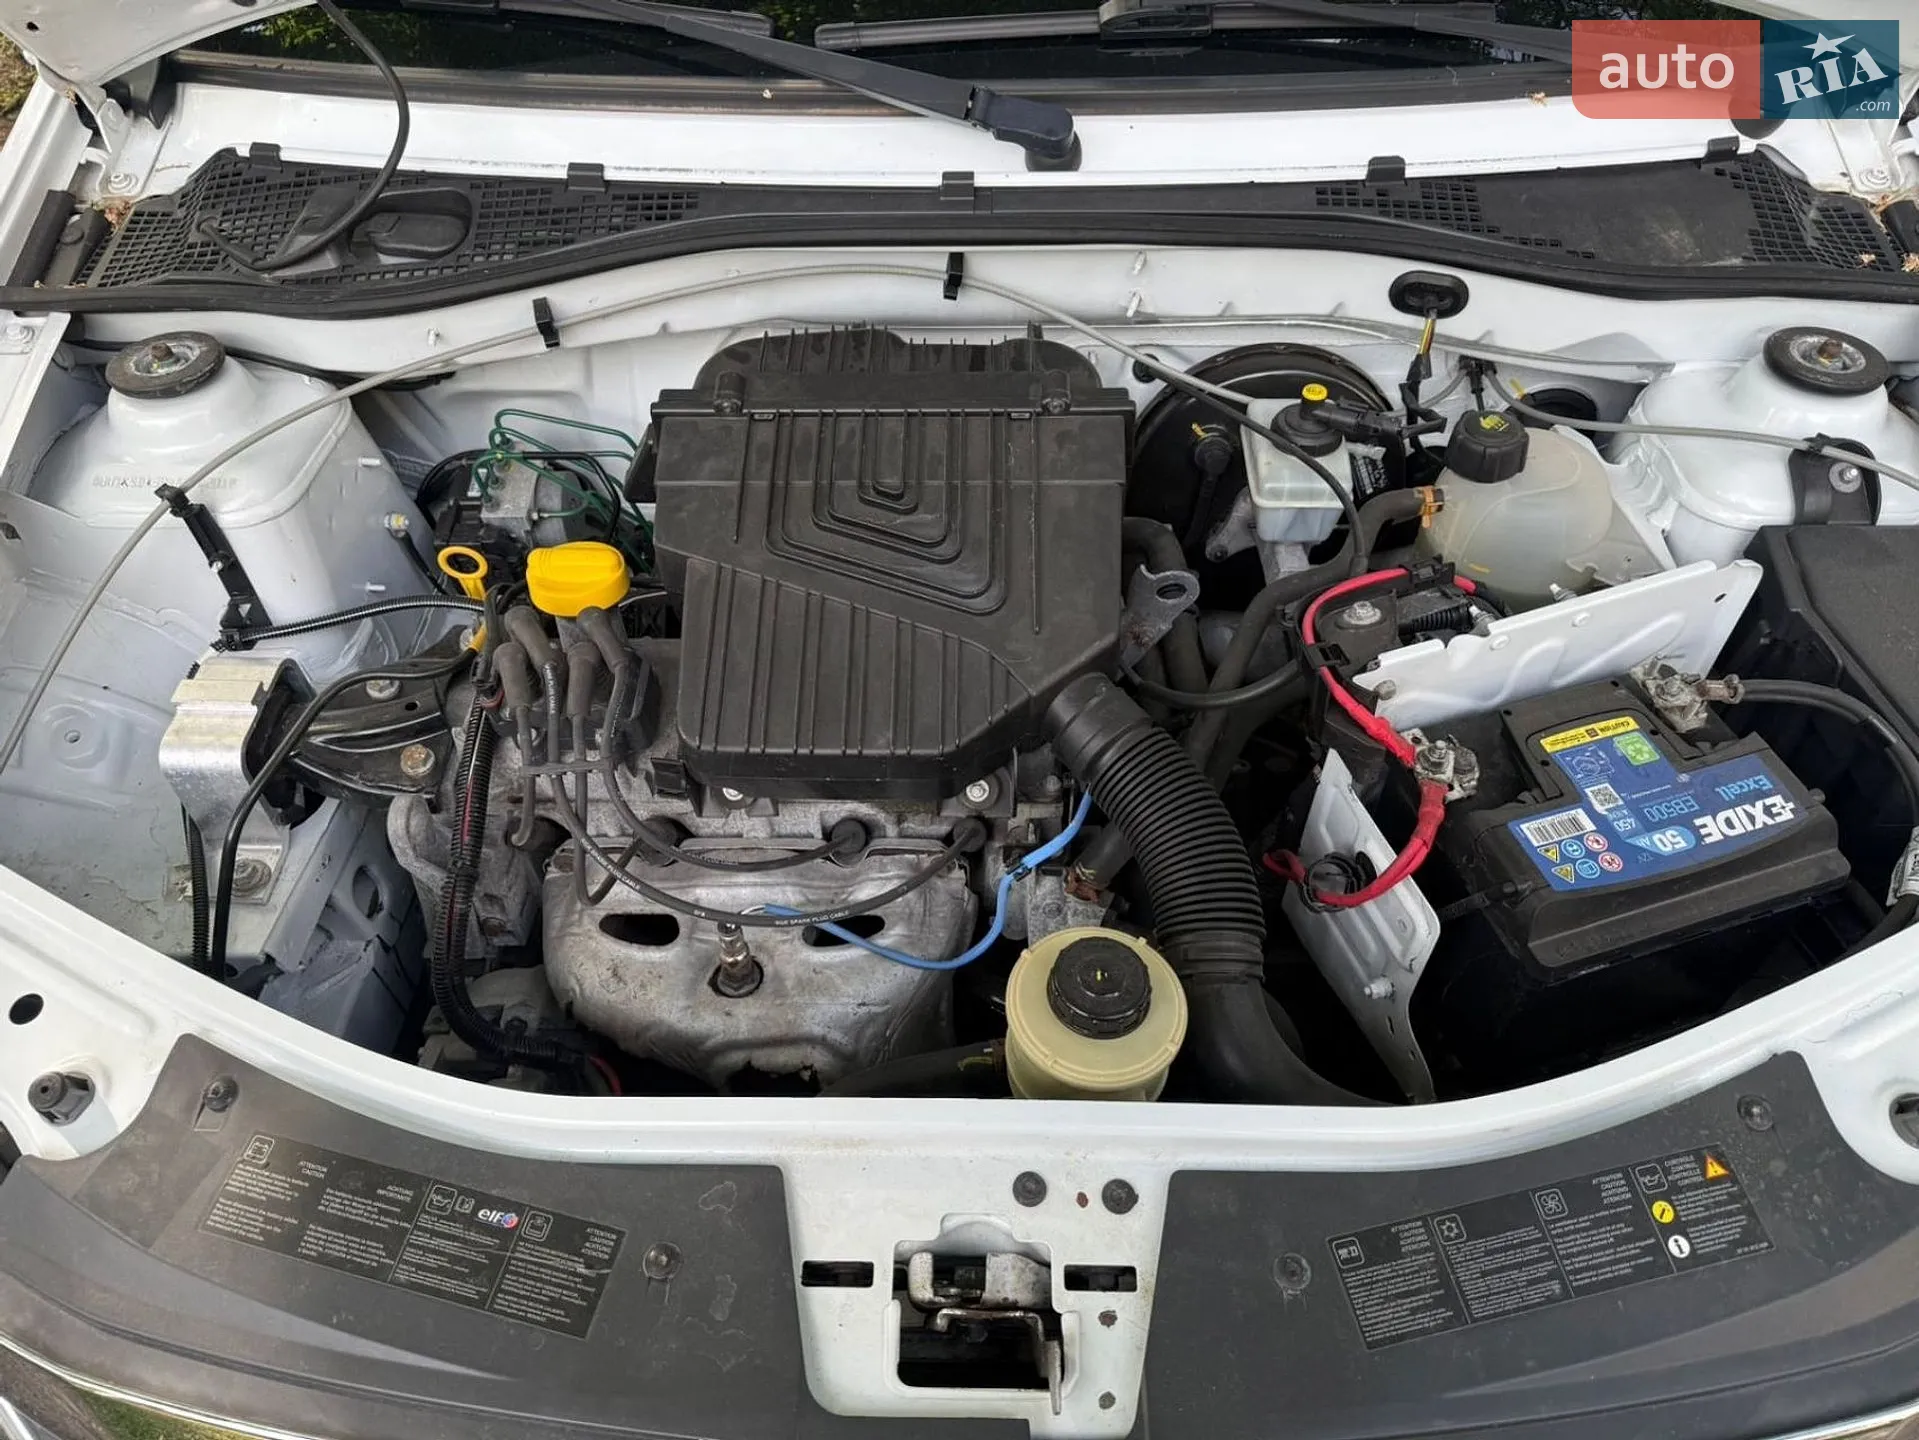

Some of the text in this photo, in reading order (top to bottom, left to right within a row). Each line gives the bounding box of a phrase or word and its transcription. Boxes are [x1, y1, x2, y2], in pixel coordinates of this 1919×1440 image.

[1598, 720, 1630, 734] CAUTION
[1714, 774, 1773, 801] Excell
[1643, 795, 1700, 822] EB500
[1693, 794, 1796, 844] EXIDE
[1613, 818, 1636, 832] 450
[1652, 829, 1688, 852] 50
[477, 1208, 504, 1223] elf
